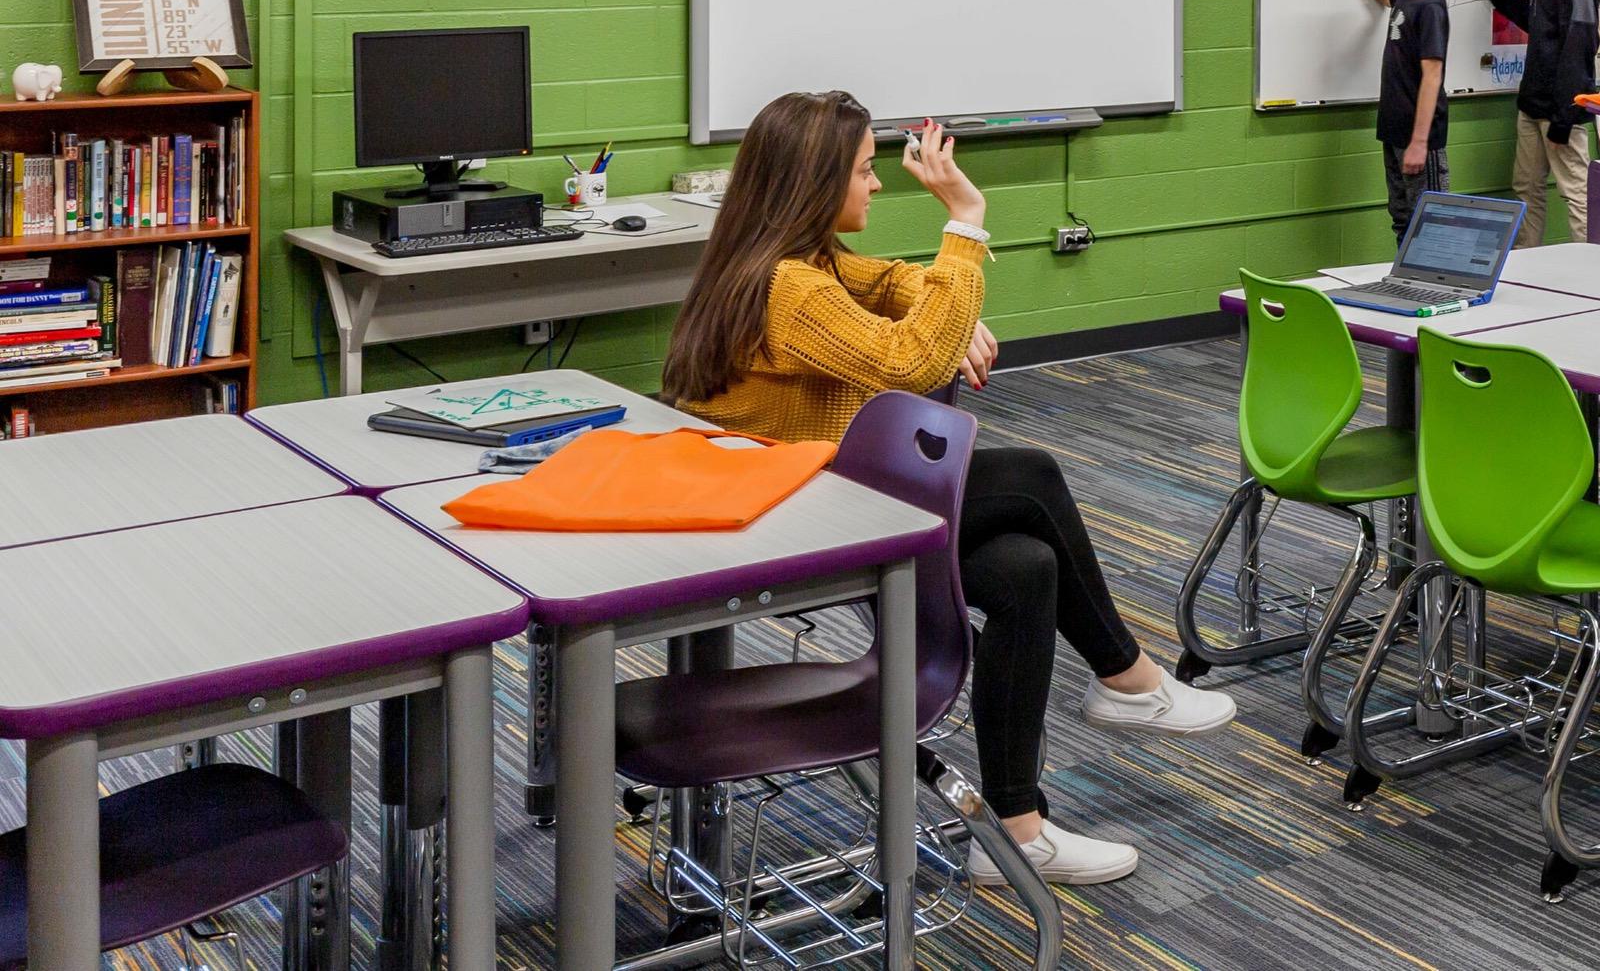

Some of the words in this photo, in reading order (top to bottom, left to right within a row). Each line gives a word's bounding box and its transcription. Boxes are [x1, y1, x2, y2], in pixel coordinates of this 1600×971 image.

[203, 38, 223, 53] W
[1491, 52, 1523, 83] Adapta
[26, 295, 48, 303] DANNY
